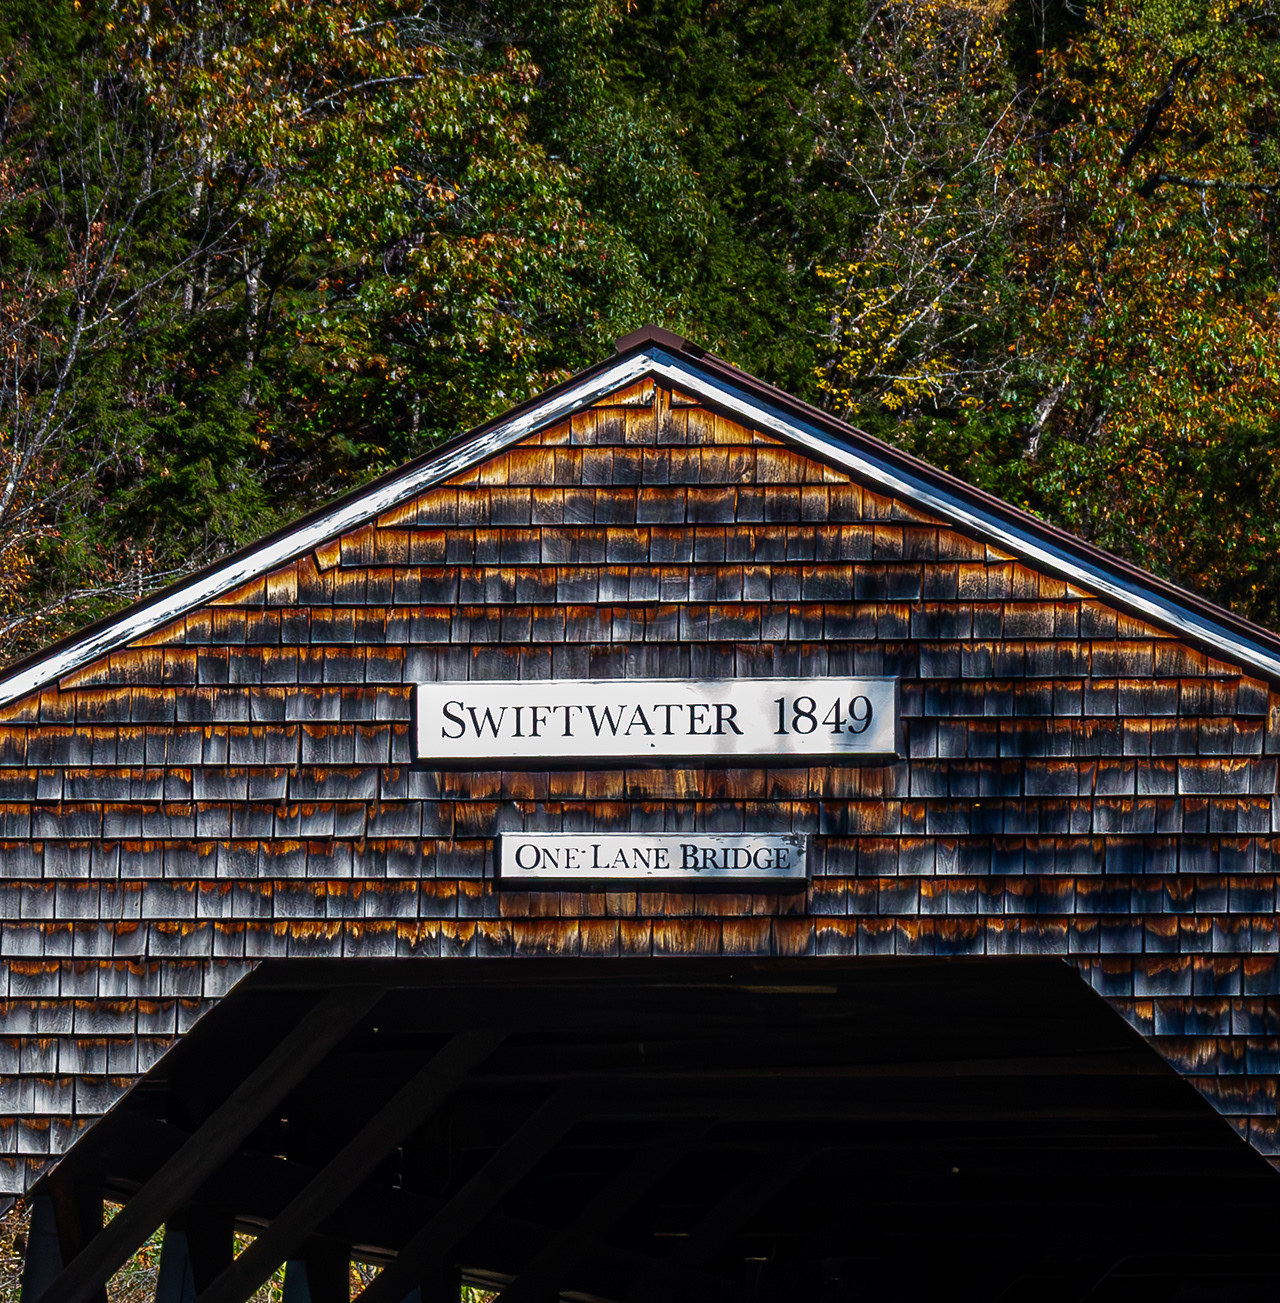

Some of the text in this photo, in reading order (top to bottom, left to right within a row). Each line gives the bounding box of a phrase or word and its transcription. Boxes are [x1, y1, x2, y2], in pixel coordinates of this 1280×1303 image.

[441, 695, 874, 739] SWIFTWATER 1849
[515, 843, 791, 871] ONE LANE BRIDGE
